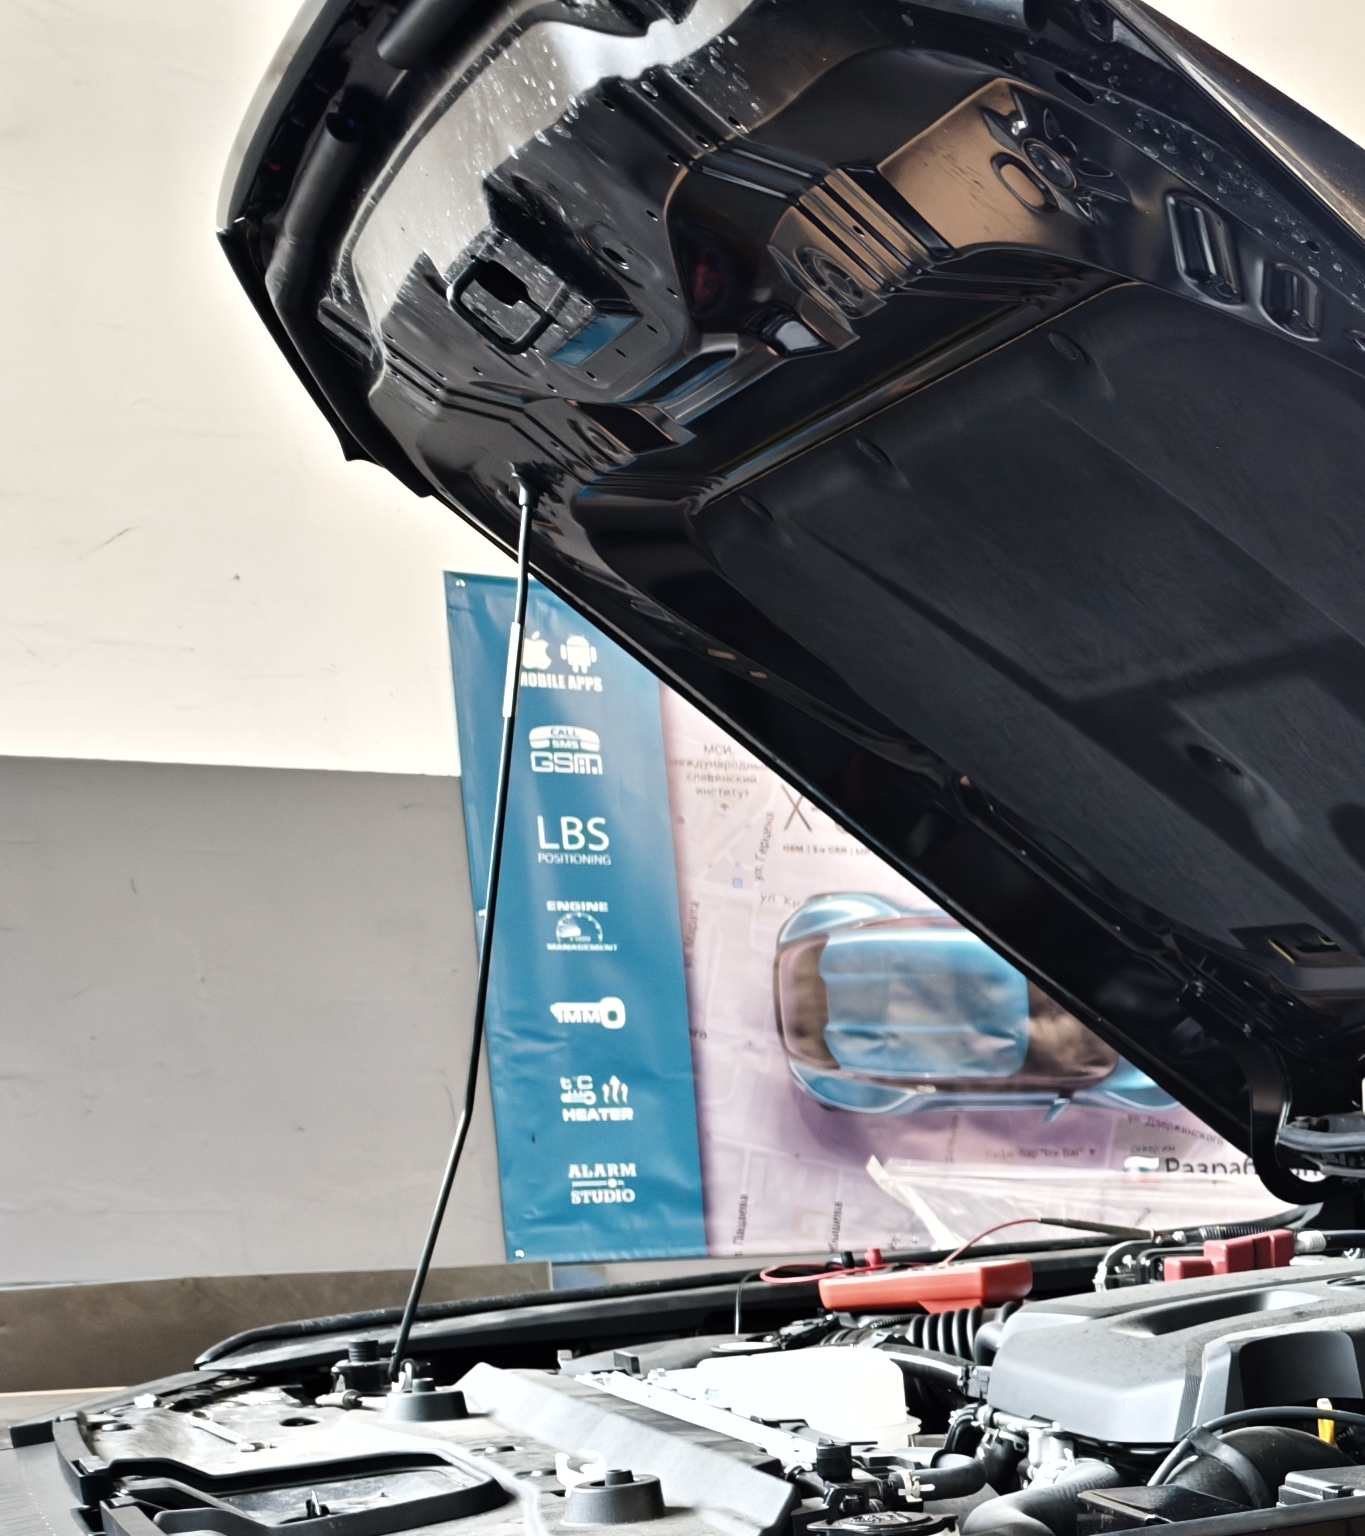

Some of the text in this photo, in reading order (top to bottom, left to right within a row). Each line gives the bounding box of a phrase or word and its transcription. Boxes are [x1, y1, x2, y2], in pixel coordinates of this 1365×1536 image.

[567, 674, 604, 693] APPS
[550, 728, 579, 738] CALL
[551, 739, 580, 750] SMS
[536, 815, 611, 852] LBS
[537, 852, 612, 866] POSITIONING
[546, 901, 609, 912] ENGINE
[546, 943, 618, 952] MANAGEMENT
[556, 996, 626, 1030] IMMO
[562, 1107, 634, 1122] HEATER
[568, 1162, 637, 1179] ALARM
[570, 1187, 636, 1205] STUDIO
